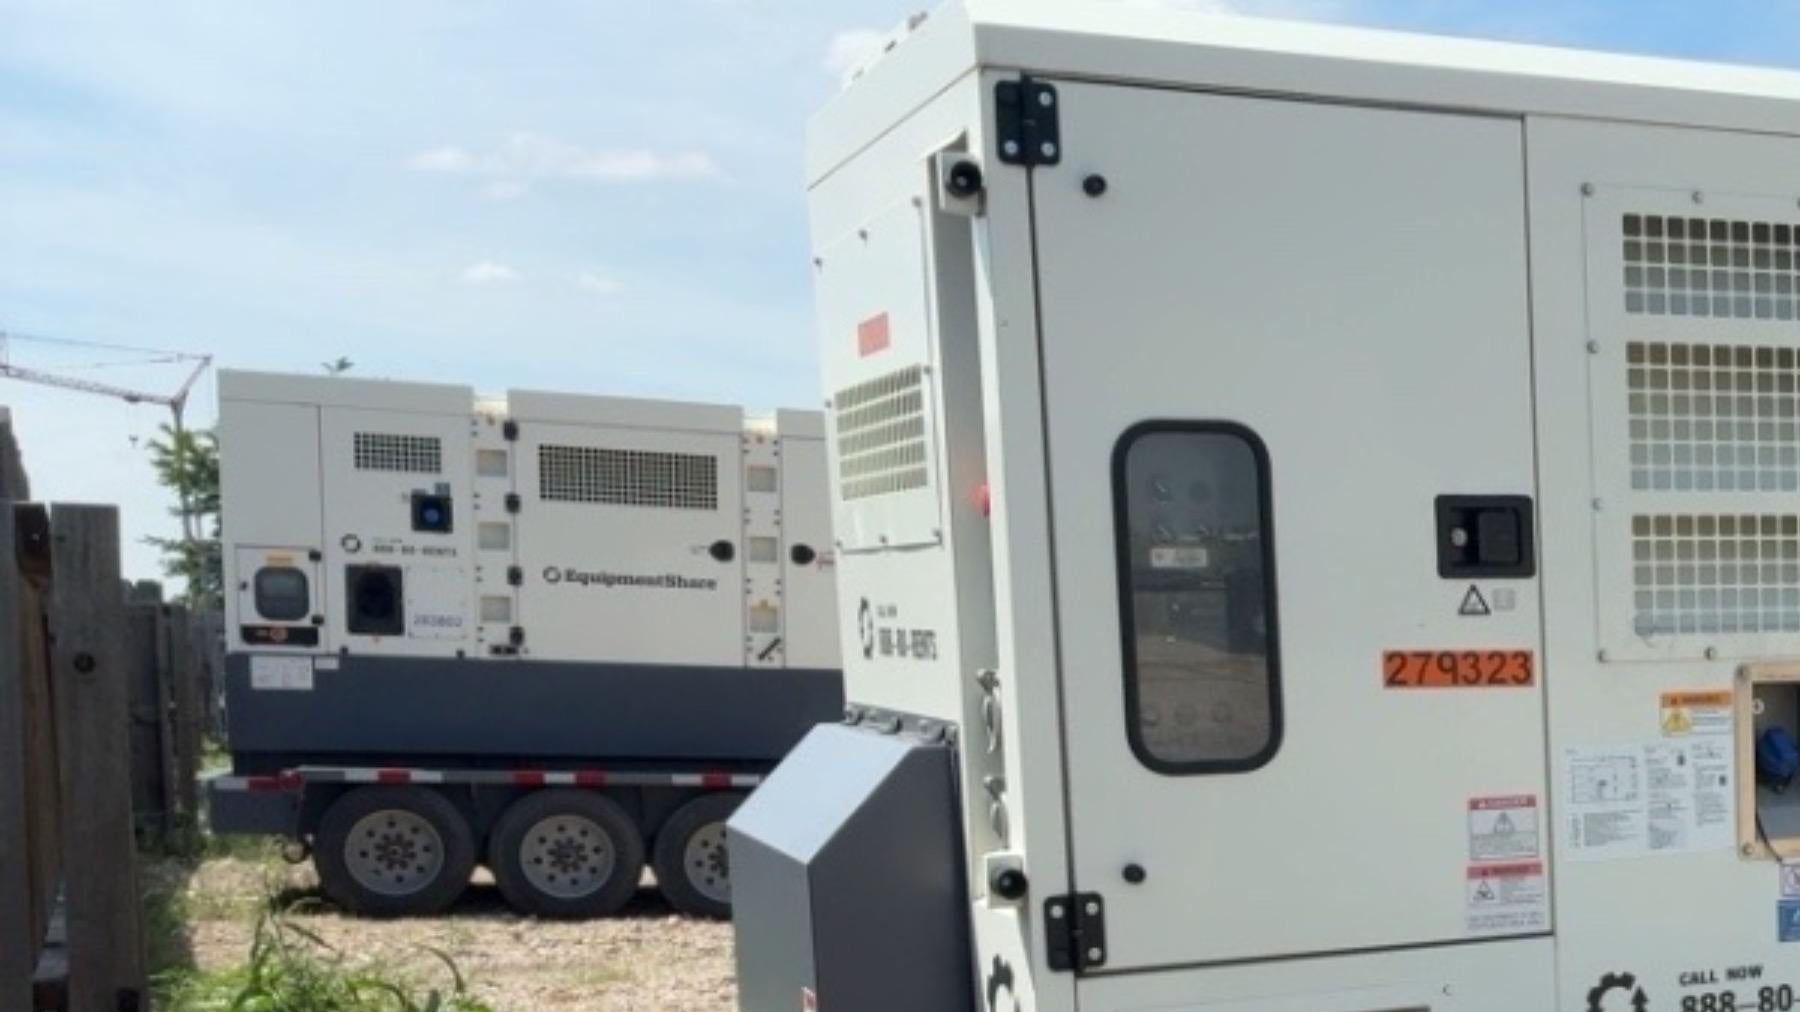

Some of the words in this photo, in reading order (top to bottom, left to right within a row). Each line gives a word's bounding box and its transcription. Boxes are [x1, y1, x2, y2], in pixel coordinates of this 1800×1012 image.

[564, 568, 718, 590] EquipmentShare
[1385, 650, 1533, 686] 279323
[1679, 968, 1719, 986] CALL
[1725, 964, 1764, 981] NOW
